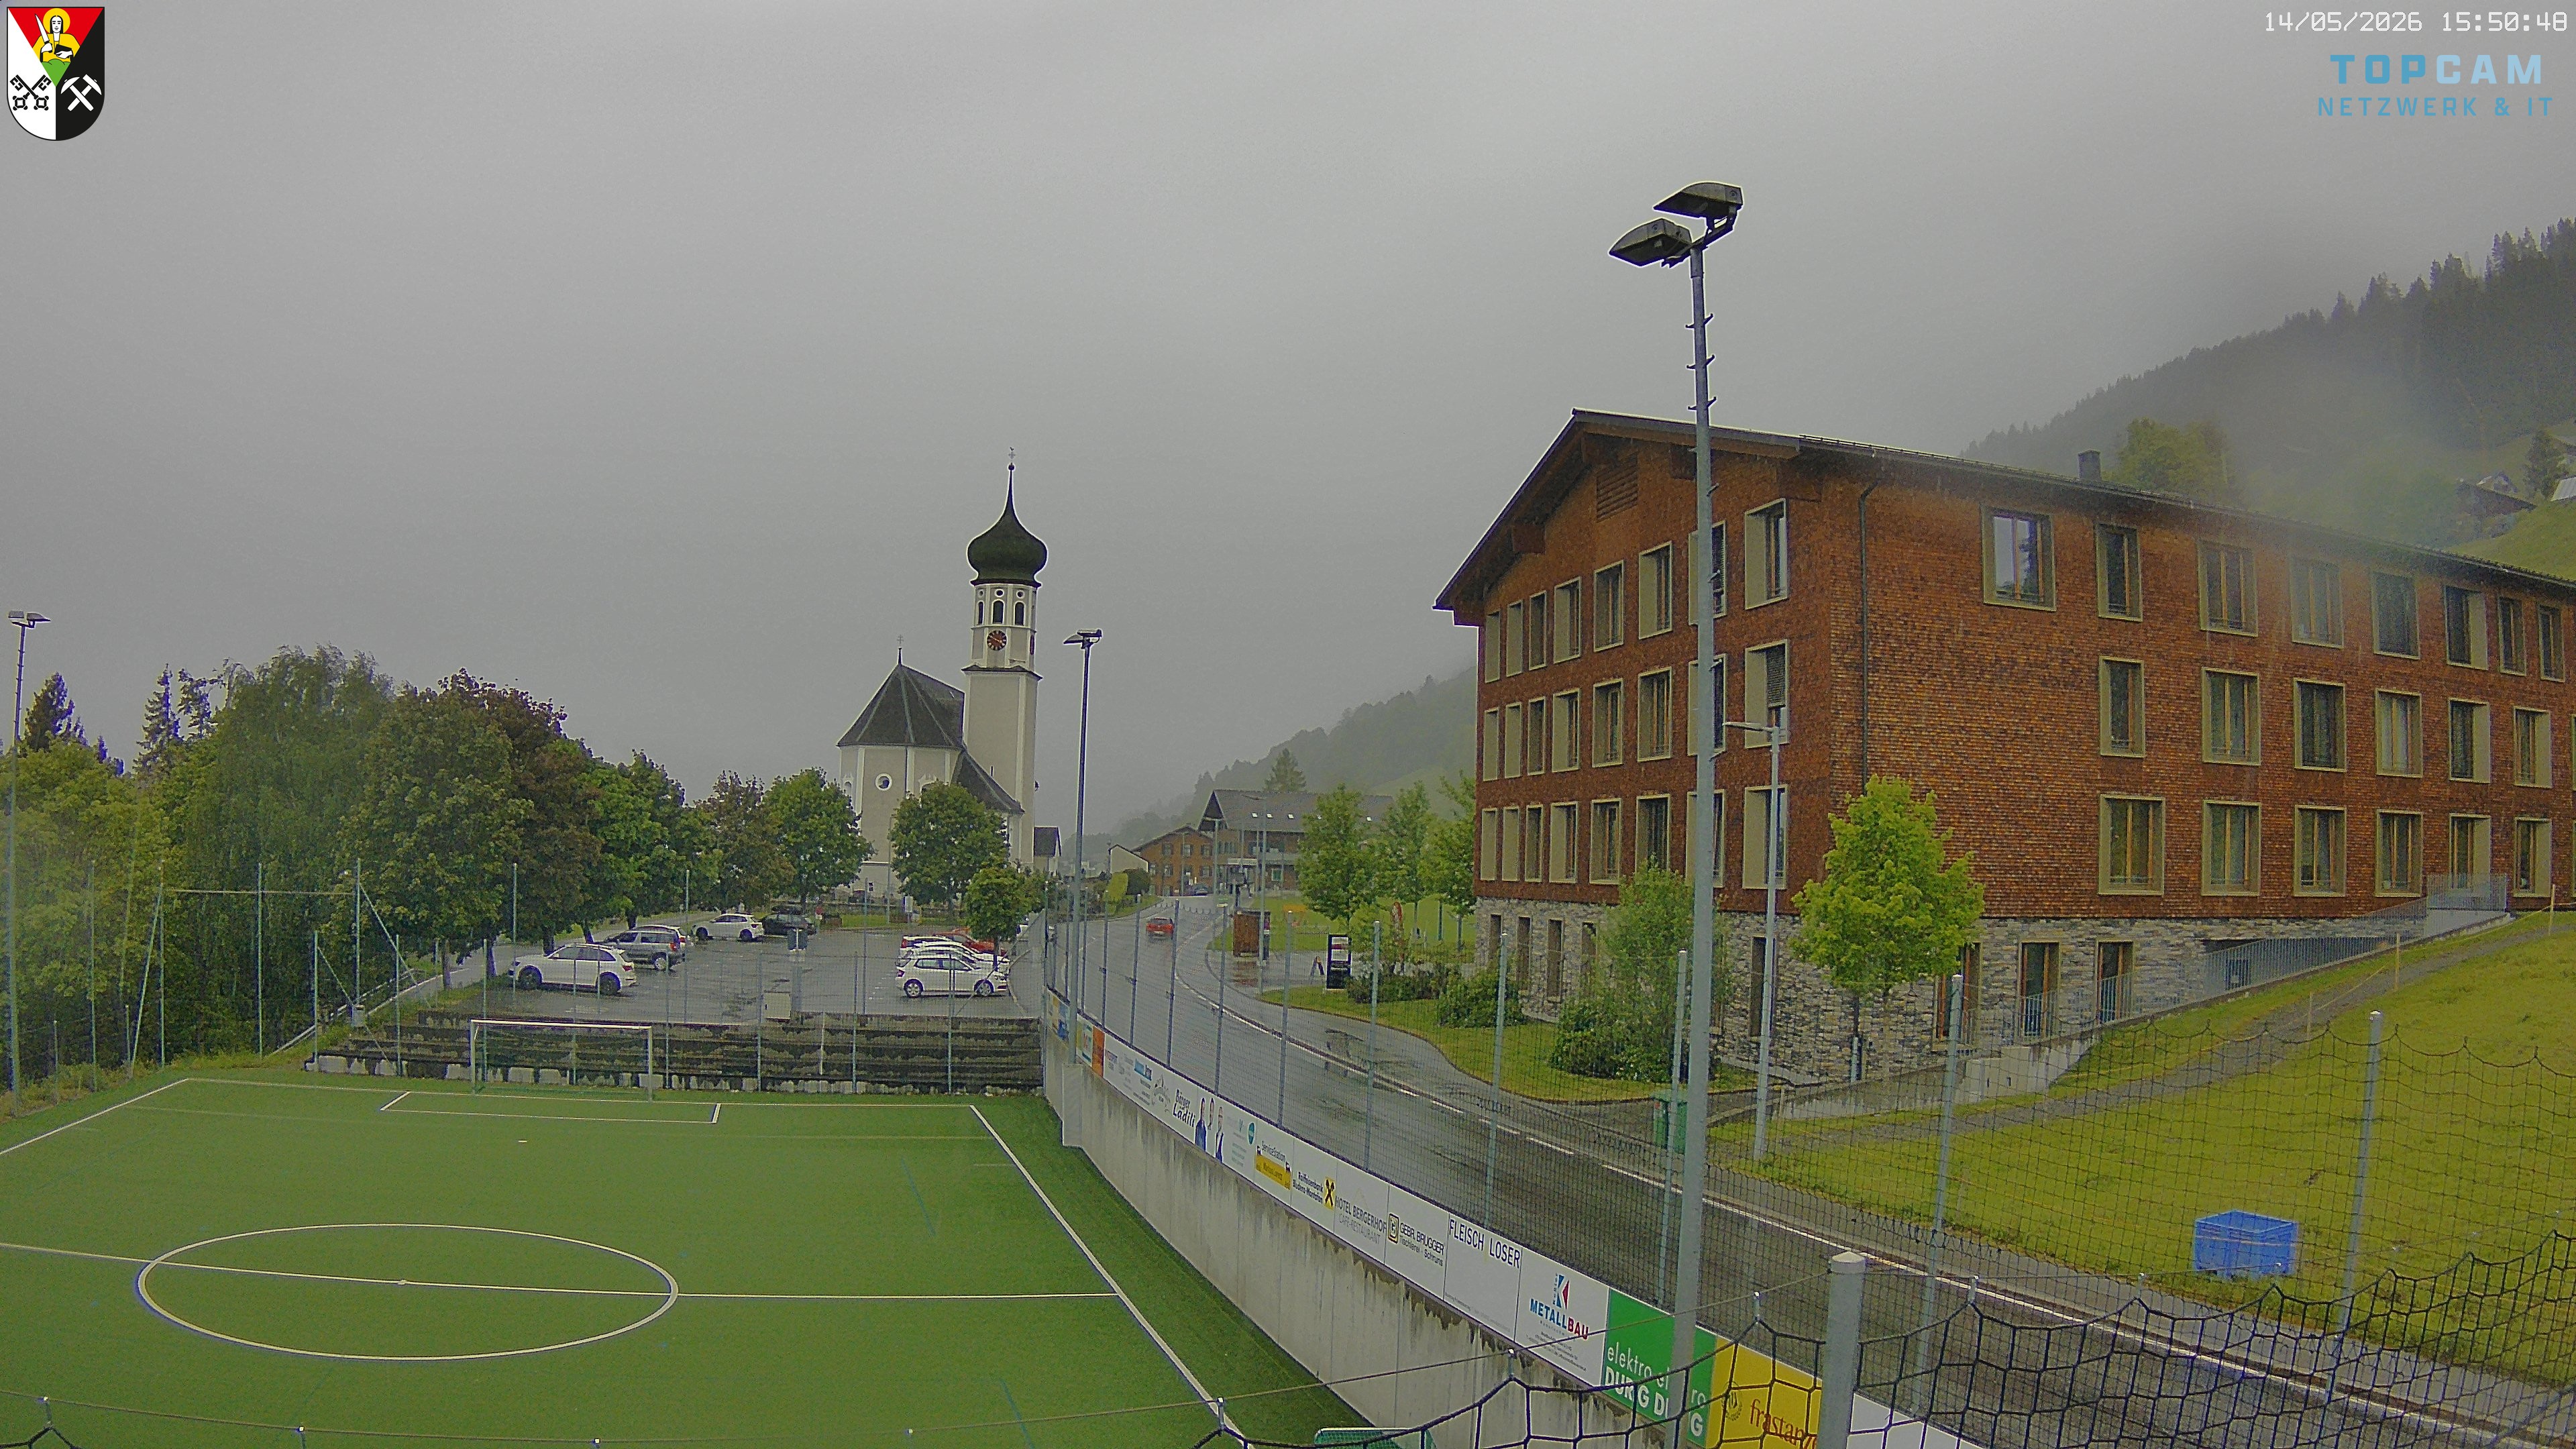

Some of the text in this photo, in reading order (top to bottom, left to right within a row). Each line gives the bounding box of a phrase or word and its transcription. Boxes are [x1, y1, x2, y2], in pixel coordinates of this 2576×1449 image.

[1335, 1195, 1387, 1234] HOTEL BERGERHOF
[1449, 1219, 1521, 1269] FLEISCH LOSER
[1529, 1297, 1589, 1340] METALLBAU
[1607, 1342, 1652, 1379] elektro
[1605, 1366, 1650, 1408] DURG
